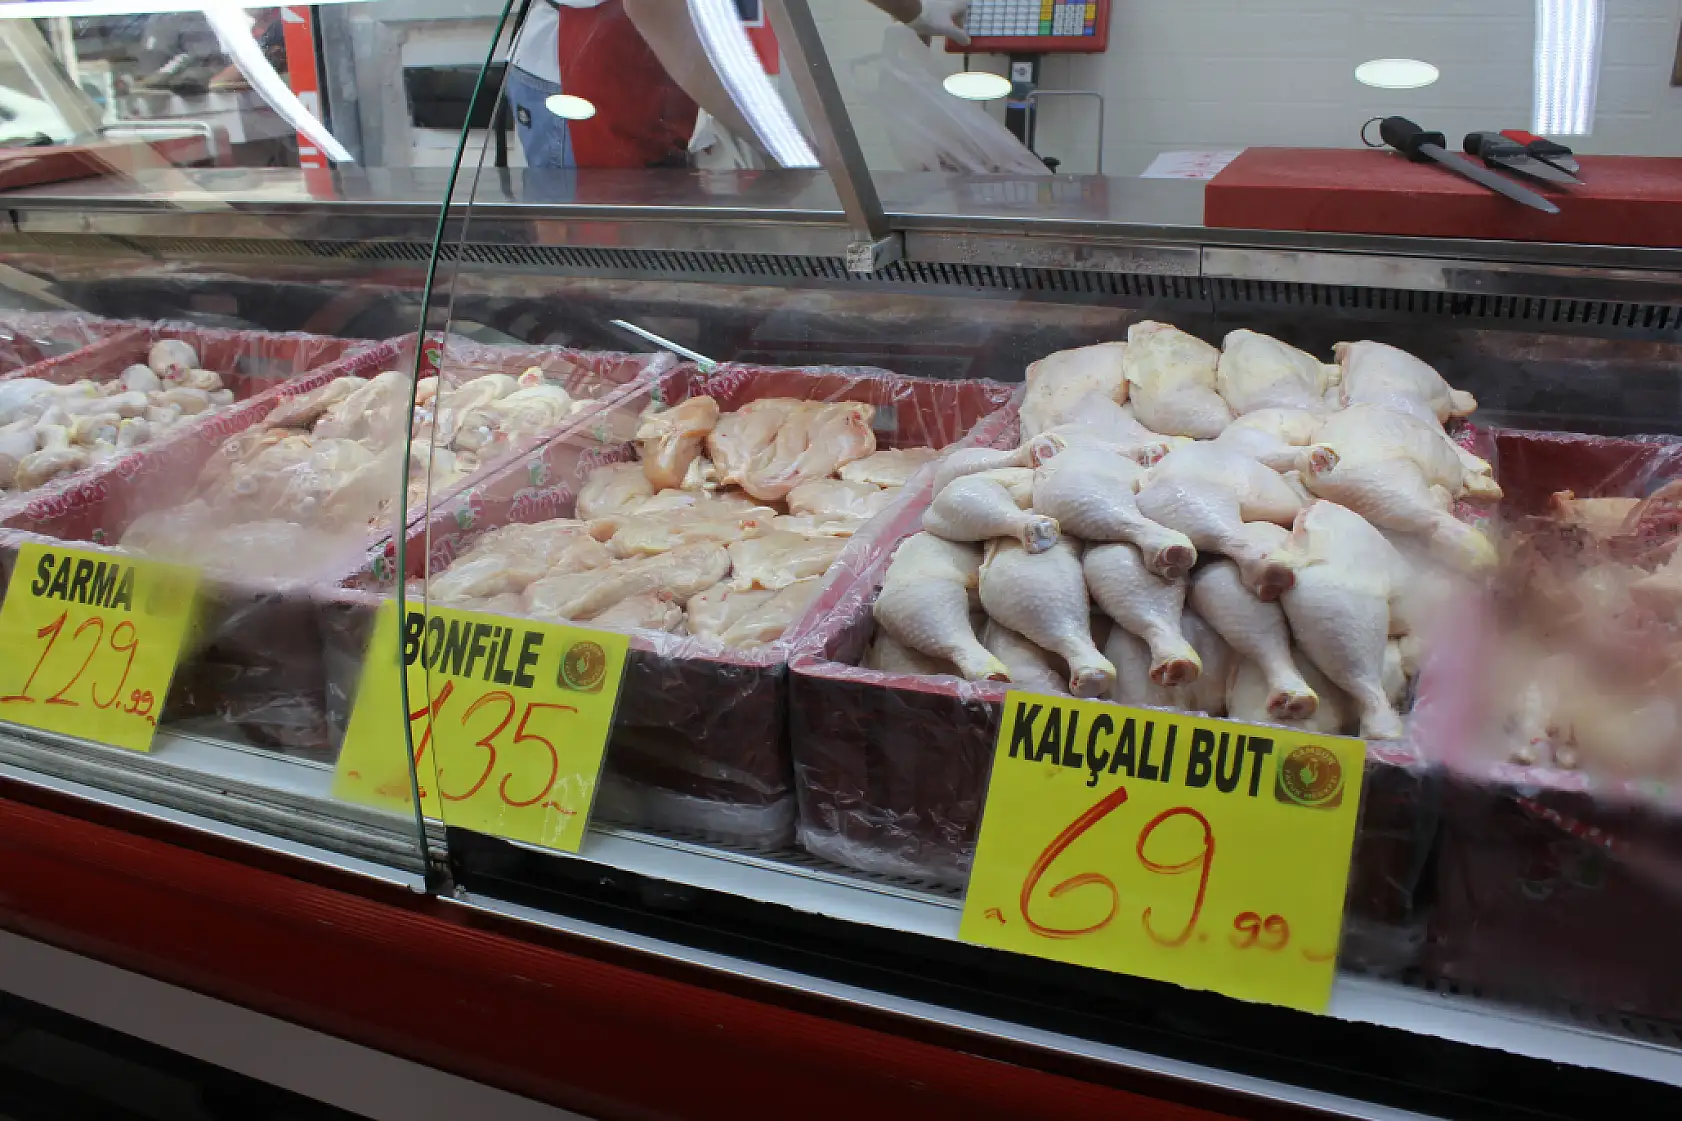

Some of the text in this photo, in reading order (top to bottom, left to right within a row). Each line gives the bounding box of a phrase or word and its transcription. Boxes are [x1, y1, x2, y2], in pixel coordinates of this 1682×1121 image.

[31, 553, 136, 612] SARMA
[1008, 701, 1274, 797] KALÇALI BUT
